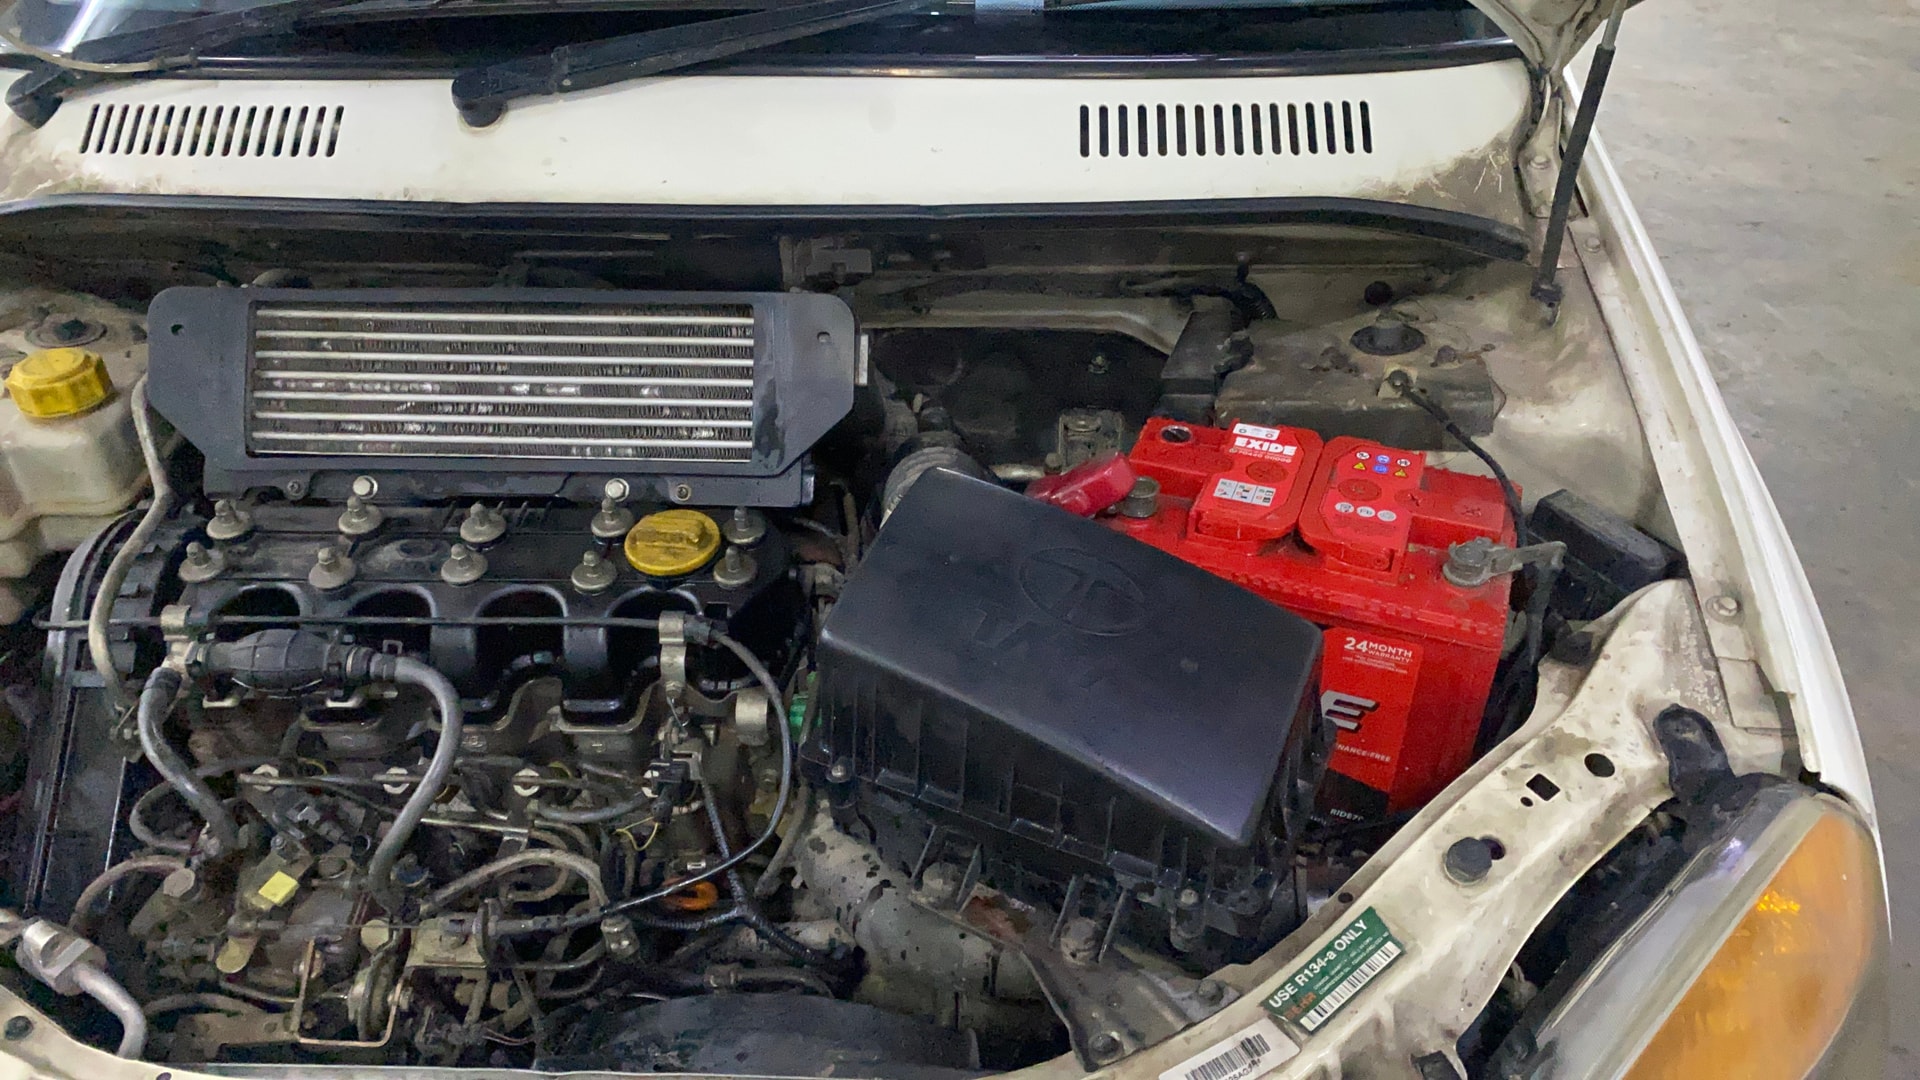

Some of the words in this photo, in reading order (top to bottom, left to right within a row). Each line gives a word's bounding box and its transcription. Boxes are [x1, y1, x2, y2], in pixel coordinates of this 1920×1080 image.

[1234, 436, 1298, 457] EXIDE
[1343, 636, 1368, 653] 24
[1368, 641, 1413, 658] MONTH
[1335, 744, 1391, 762] NANCE-FREE
[1268, 982, 1298, 1008] USE
[1294, 951, 1337, 986] R134-a
[1334, 919, 1367, 951] ONLY
